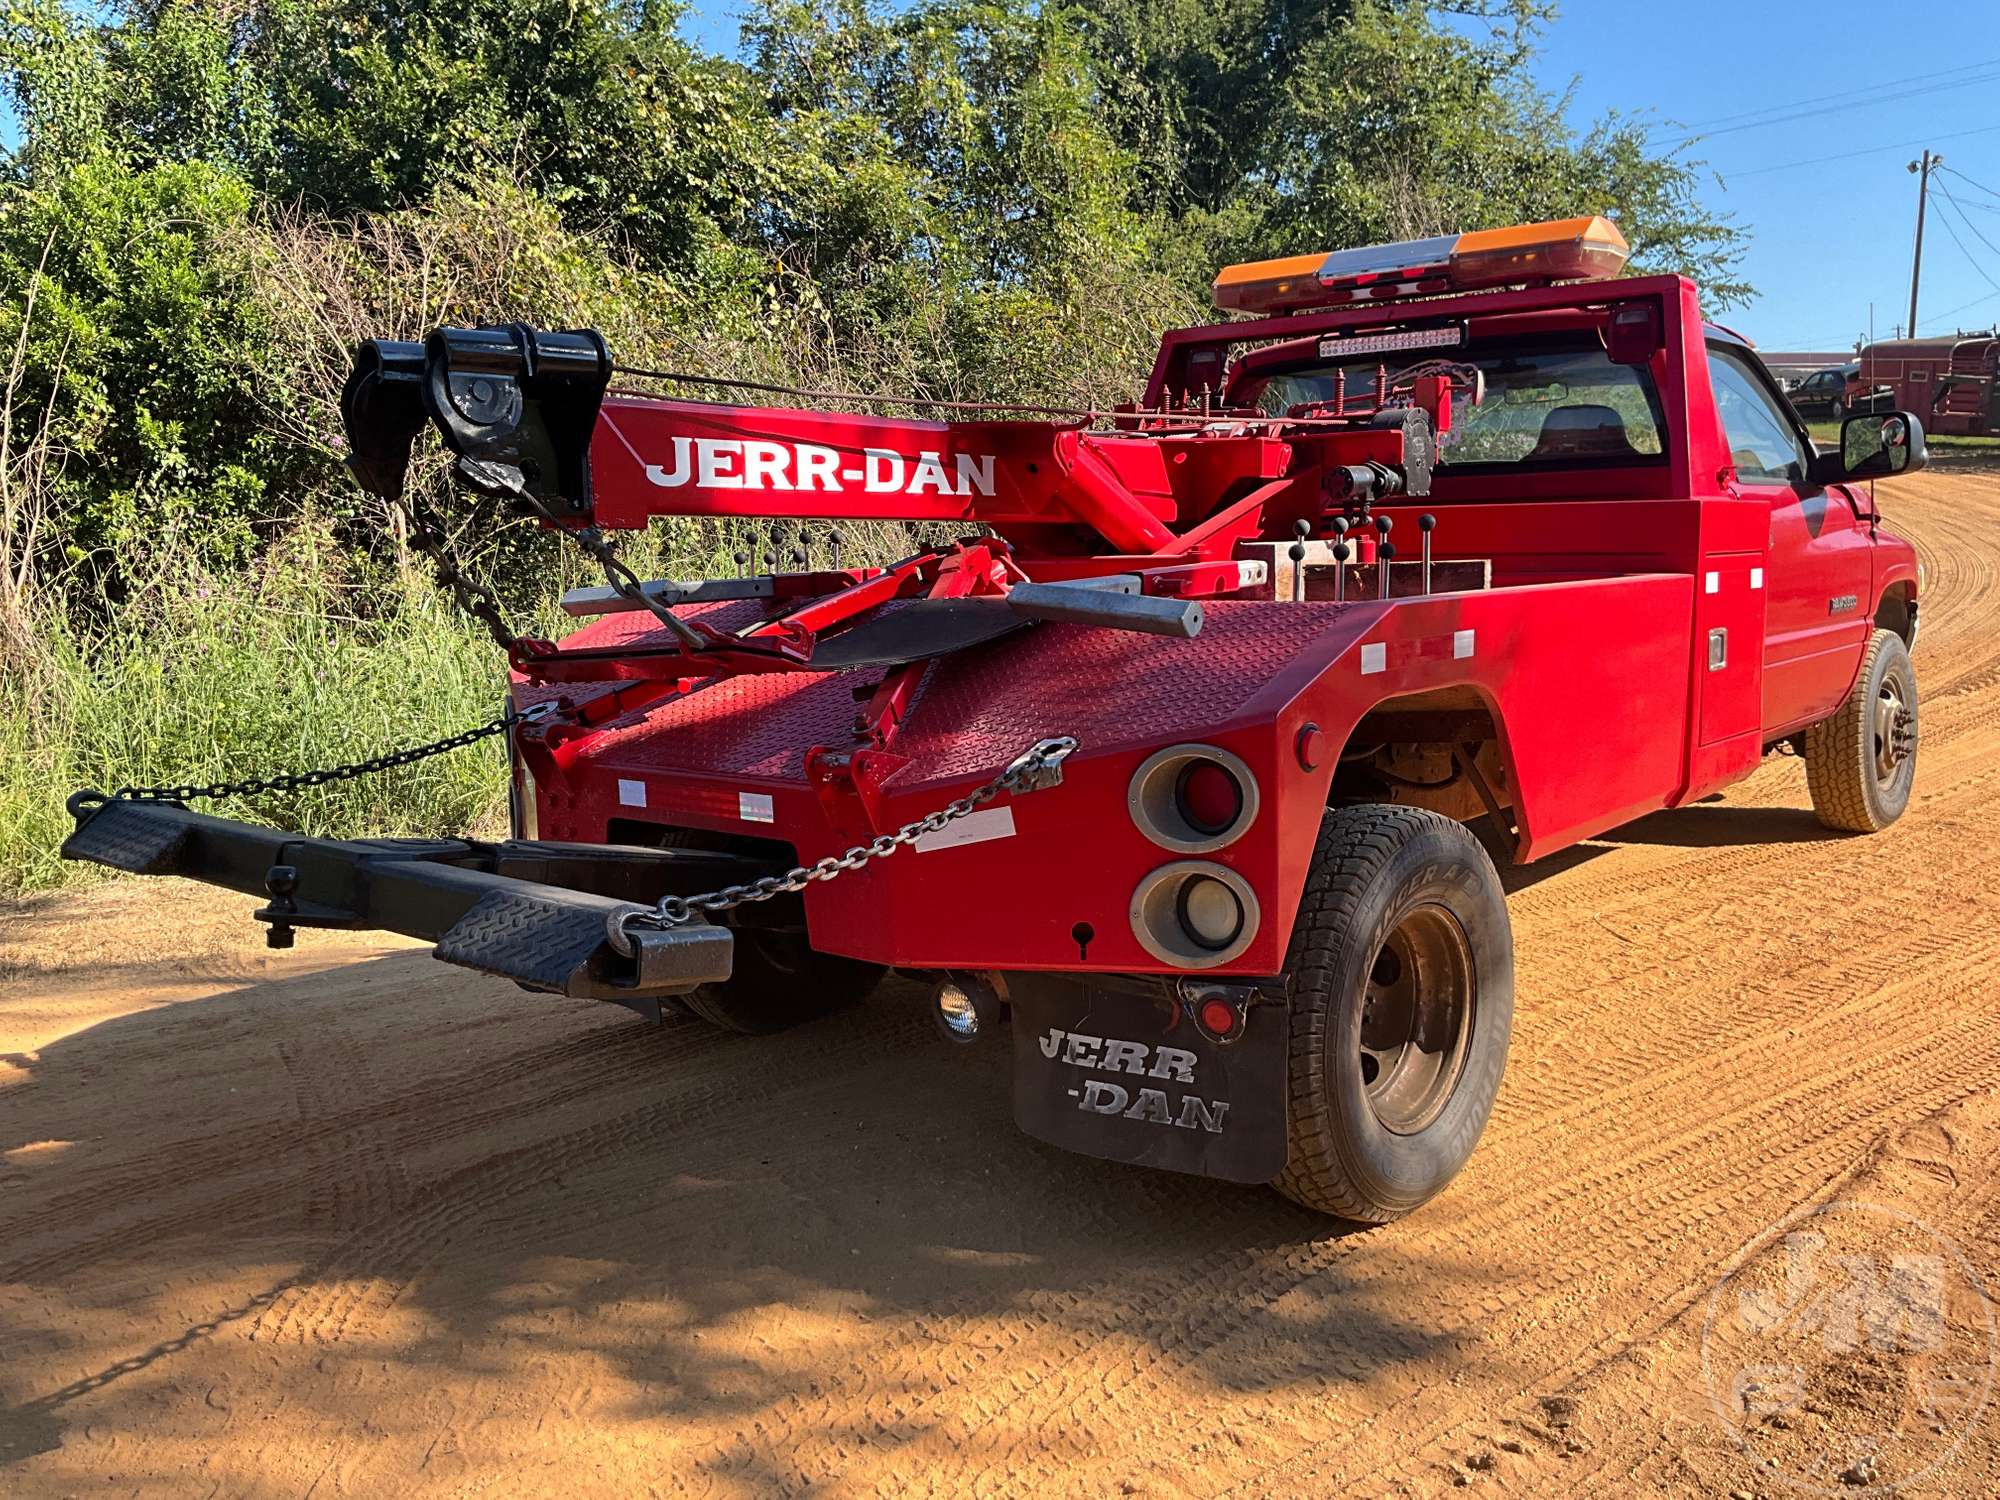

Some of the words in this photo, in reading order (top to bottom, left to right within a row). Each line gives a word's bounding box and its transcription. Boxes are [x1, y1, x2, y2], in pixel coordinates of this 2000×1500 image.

[645, 436, 997, 497] JERR-DAN
[1038, 1027, 1199, 1084] JERR
[1067, 1079, 1230, 1135] -DAN
